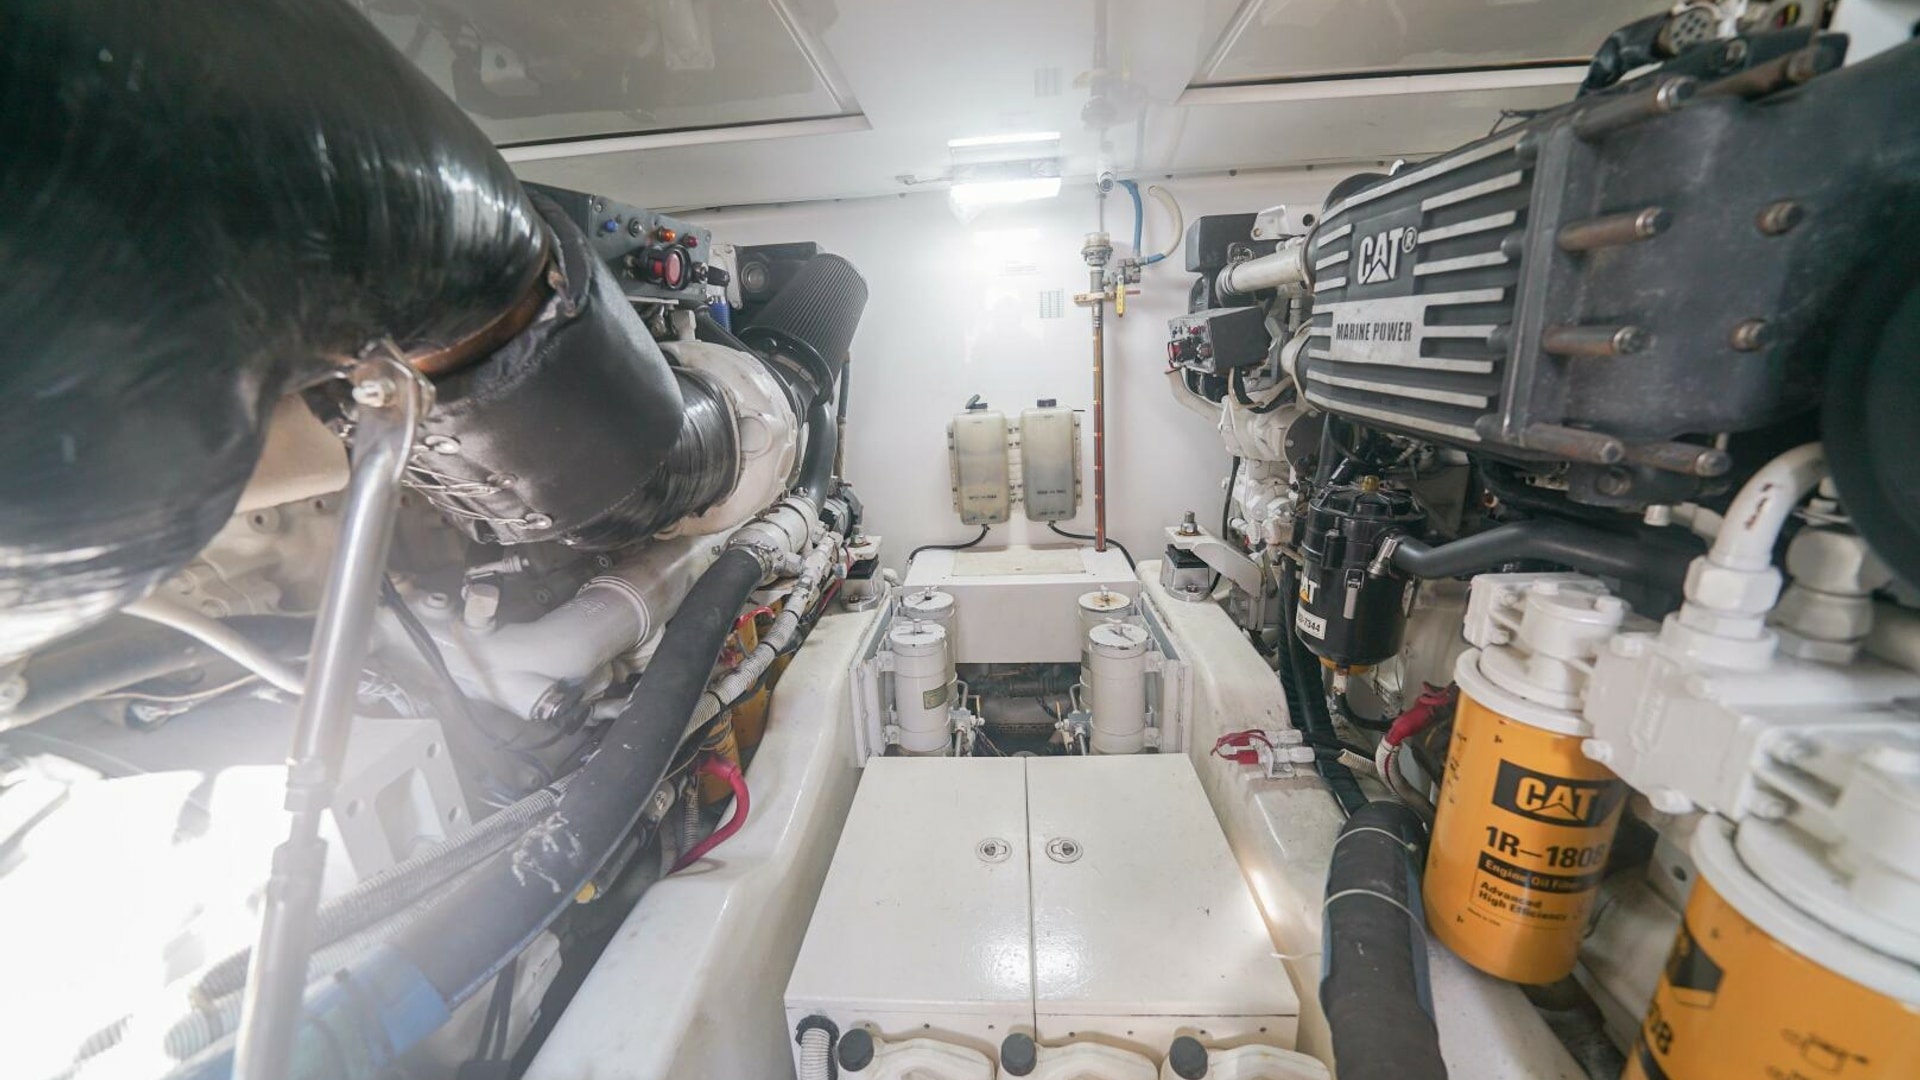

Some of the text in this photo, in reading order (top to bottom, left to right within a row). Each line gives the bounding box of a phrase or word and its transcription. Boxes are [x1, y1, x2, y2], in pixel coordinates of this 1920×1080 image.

[1336, 321, 1412, 342] MARINE POWER
[1515, 776, 1598, 823] CAT
[1485, 858, 1528, 885] Engine
[1479, 890, 1507, 909] High
[1480, 881, 1543, 909] Advanced
